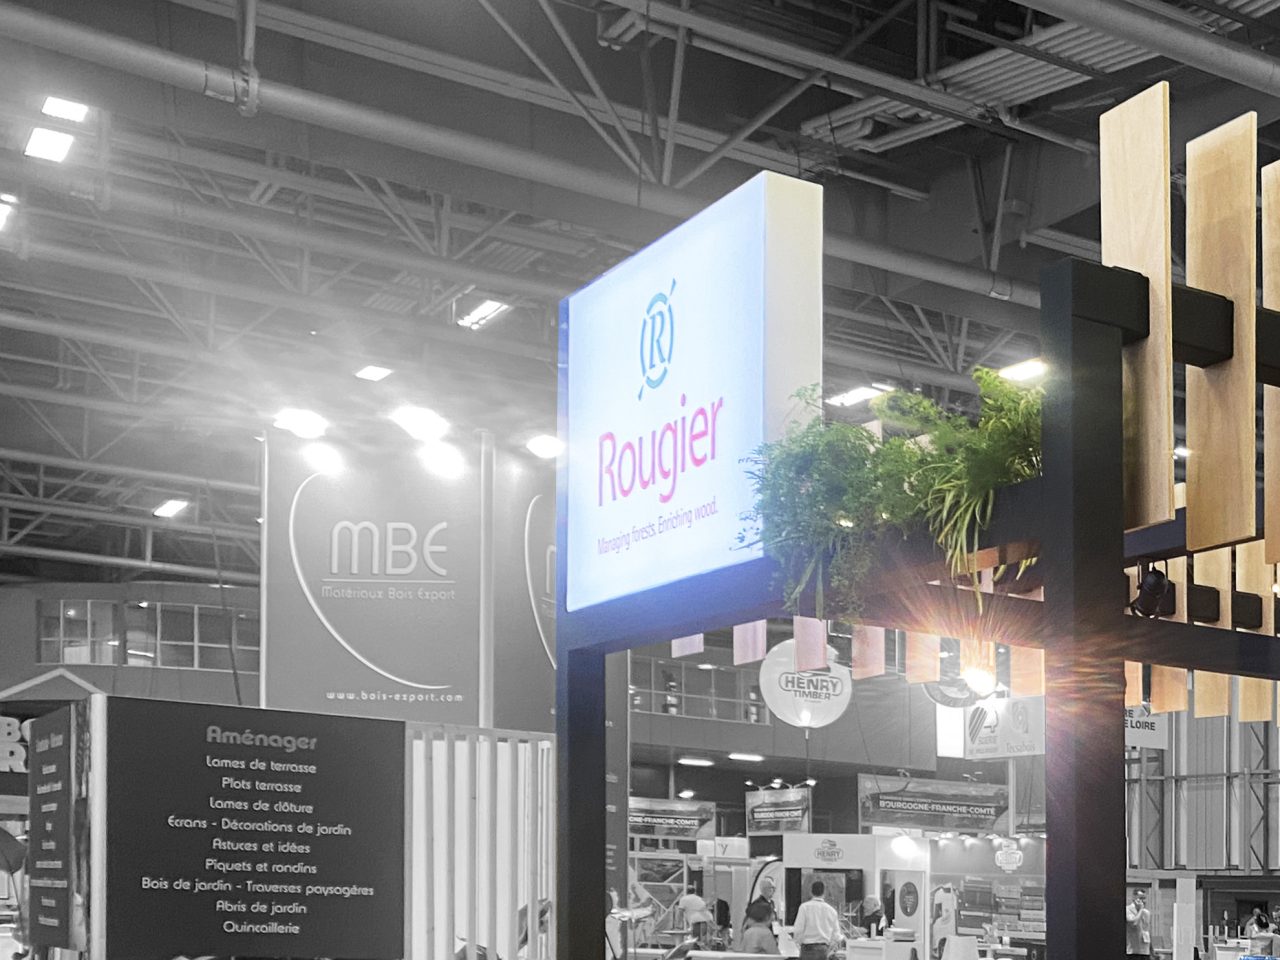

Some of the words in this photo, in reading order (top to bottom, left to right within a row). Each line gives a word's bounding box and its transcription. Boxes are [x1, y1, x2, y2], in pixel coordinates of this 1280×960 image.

[599, 393, 724, 507] Rougier
[598, 536, 630, 555] Managing
[658, 506, 692, 534] Enriching
[331, 520, 448, 576] MBE
[388, 587, 413, 600] Bois
[418, 588, 455, 603] Export
[785, 675, 839, 693] HENRY
[326, 690, 463, 704] www.bois-export.com
[794, 690, 831, 701] TIMBER
[1130, 720, 1156, 731] LOIRE
[206, 725, 318, 752] Aménager
[206, 755, 246, 770] Lames
[250, 758, 267, 771] de
[270, 760, 317, 774] terrasse
[222, 777, 251, 791] Plots
[255, 780, 302, 793] terrasse
[210, 797, 249, 811] Lames
[252, 799, 270, 812] de
[274, 801, 314, 814] clôture
[221, 817, 294, 833] Décorations
[297, 822, 314, 834] de
[316, 823, 352, 837] jardin
[212, 838, 258, 852] Astuces
[262, 841, 274, 853] et
[205, 858, 251, 873] Piquets
[256, 860, 268, 872] et
[272, 862, 317, 875] rondins
[142, 876, 169, 890] Bois
[173, 878, 191, 891] de
[193, 878, 232, 893] jardin
[246, 880, 301, 895] Traverses
[305, 885, 374, 898] paysagères
[216, 900, 247, 913] Abris
[250, 901, 268, 913] de
[270, 902, 308, 916] jardin
[223, 920, 300, 934] Quincaillerie
